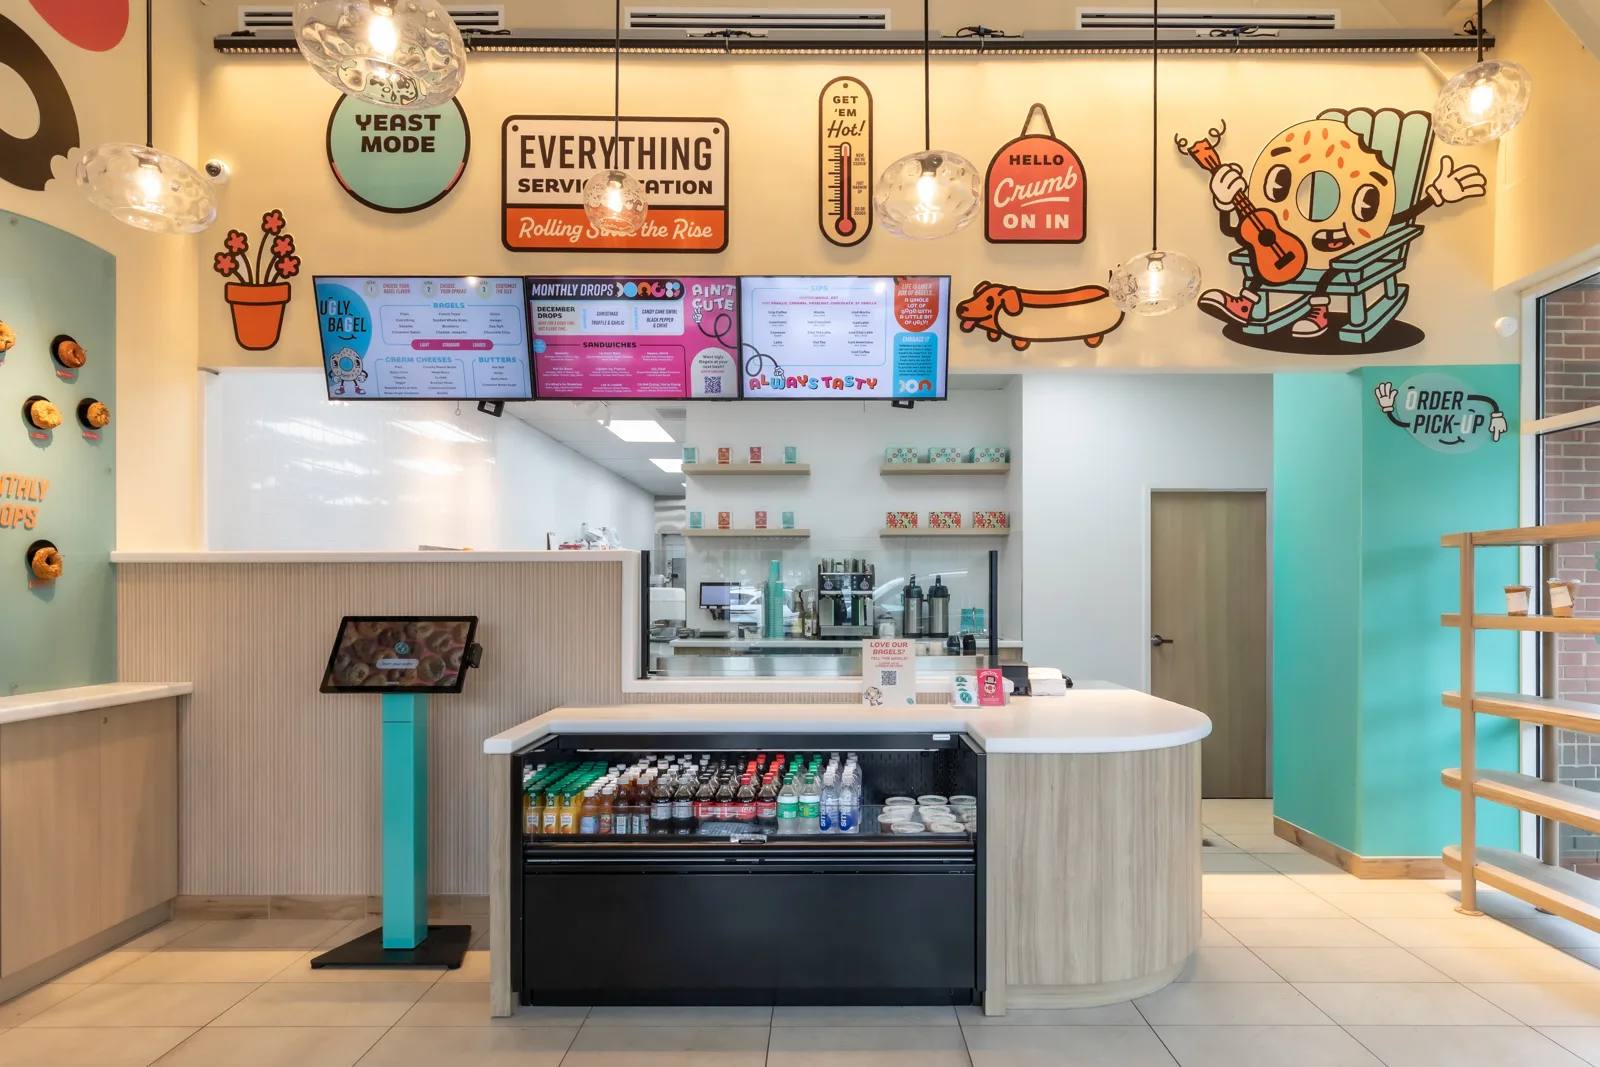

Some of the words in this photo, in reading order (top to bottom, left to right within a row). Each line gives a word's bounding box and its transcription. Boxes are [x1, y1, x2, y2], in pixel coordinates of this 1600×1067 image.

[833, 96, 858, 104] GET
[355, 114, 441, 131] YEAST
[827, 120, 866, 138] Hot!
[361, 136, 435, 153] MODE
[520, 135, 712, 170] EVERYTHING
[1009, 154, 1065, 166] HELLO
[518, 178, 589, 193] SERVI
[638, 180, 712, 195] ATION
[993, 165, 1078, 208] Crumb
[1003, 213, 1036, 229] ON
[1045, 213, 1070, 229] IN
[519, 217, 583, 243] Rolling
[640, 219, 669, 238] the
[672, 218, 713, 240] Rise
[531, 283, 578, 297] MONTHLY
[580, 283, 614, 297] DROPS
[692, 283, 736, 298] AIN'T
[320, 299, 350, 315] UGLY
[692, 297, 735, 311] CUTE
[328, 316, 367, 332] BAGEL
[749, 374, 818, 390] ALWAYS
[821, 375, 878, 390] TASTY
[1405, 390, 1464, 410] ORDER
[1413, 414, 1485, 434] PICK-UP
